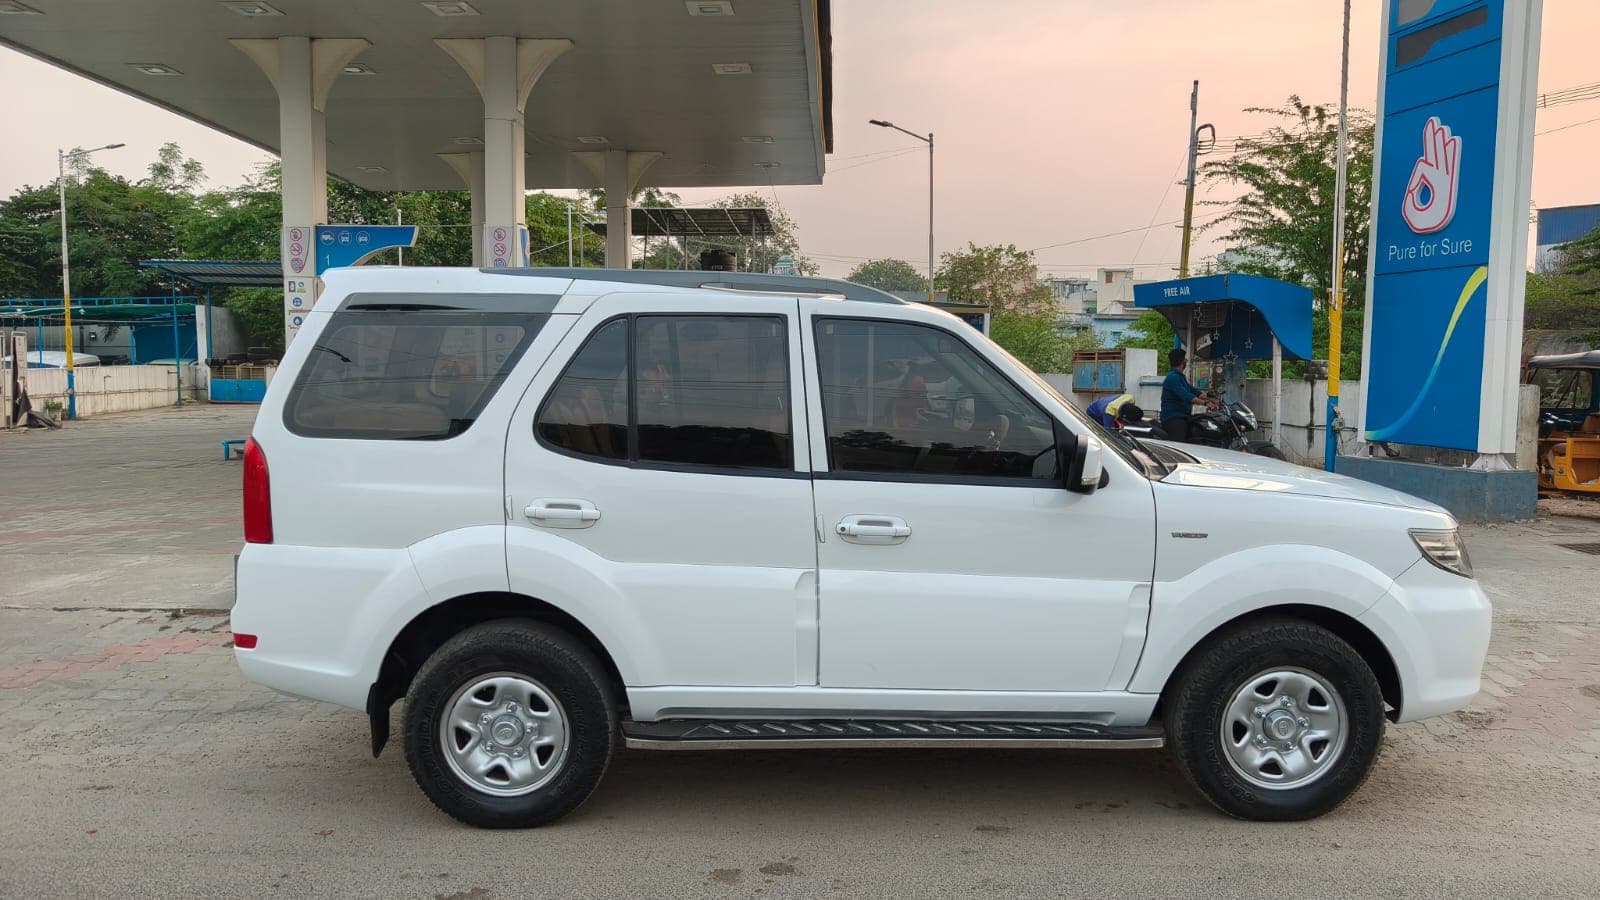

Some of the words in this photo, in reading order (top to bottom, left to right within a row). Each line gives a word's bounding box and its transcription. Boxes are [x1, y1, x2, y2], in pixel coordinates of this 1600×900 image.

[1388, 245, 1416, 261] Pure
[1420, 241, 1437, 257] for
[1441, 238, 1472, 255] Sure
[1163, 287, 1178, 298] FREE
[1180, 285, 1190, 296] AIR
